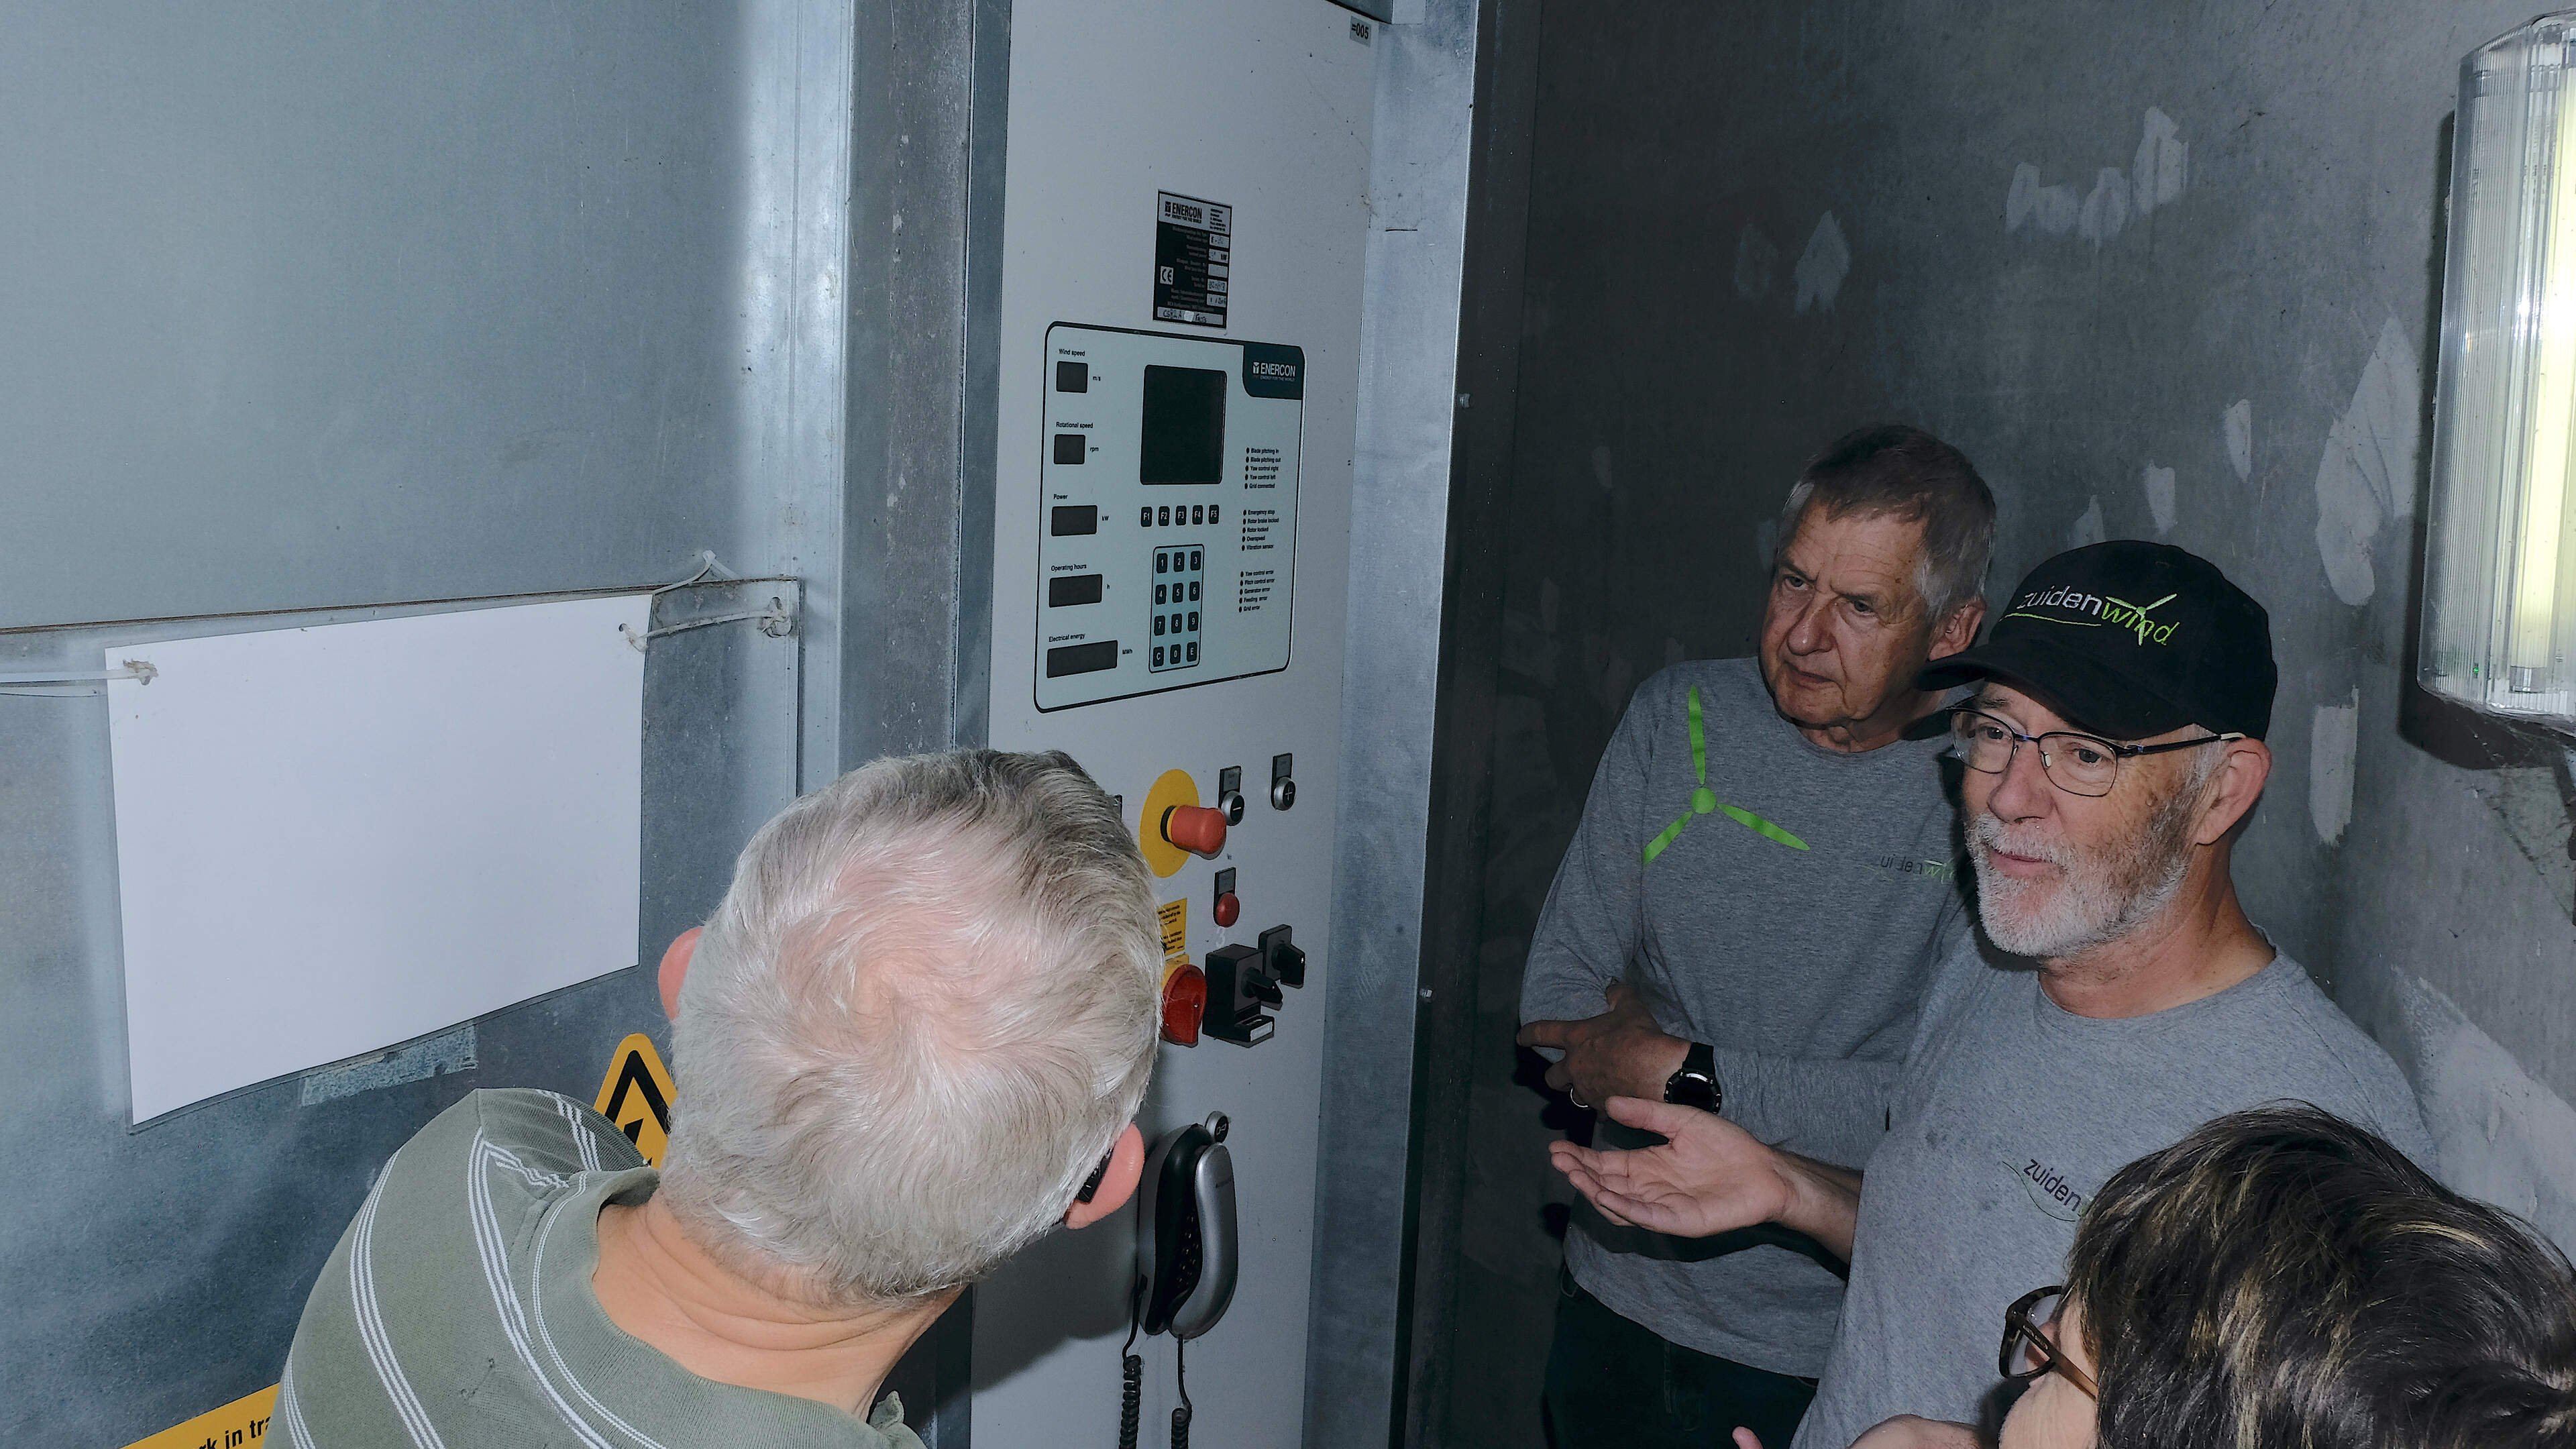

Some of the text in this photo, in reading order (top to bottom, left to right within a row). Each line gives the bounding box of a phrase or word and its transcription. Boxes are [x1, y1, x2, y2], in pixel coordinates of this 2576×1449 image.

[1172, 203, 1202, 219] ENERCON
[1162, 268, 1173, 283] CE
[1260, 362, 1296, 377] ENERCON
[1143, 513, 1150, 521] F1
[1161, 512, 1168, 520] F2
[1177, 511, 1185, 519] F3
[1194, 511, 1201, 519] F4
[1210, 510, 1218, 518] F5
[1161, 559, 1164, 567] 1
[1177, 557, 1181, 566] 2
[1193, 556, 1197, 564] 3
[1159, 590, 1163, 598] 4
[1176, 588, 1180, 596] 5
[2017, 585, 2180, 646] zuidenwind
[1158, 621, 1162, 629] 7
[1175, 619, 1179, 627] 8
[1191, 617, 1195, 625] 9
[1049, 632, 1085, 642] Electrical energy
[1174, 649, 1178, 658] 0
[1190, 647, 1194, 655] E
[1156, 652, 1161, 660] C
[225, 1430, 243, 1449] in
